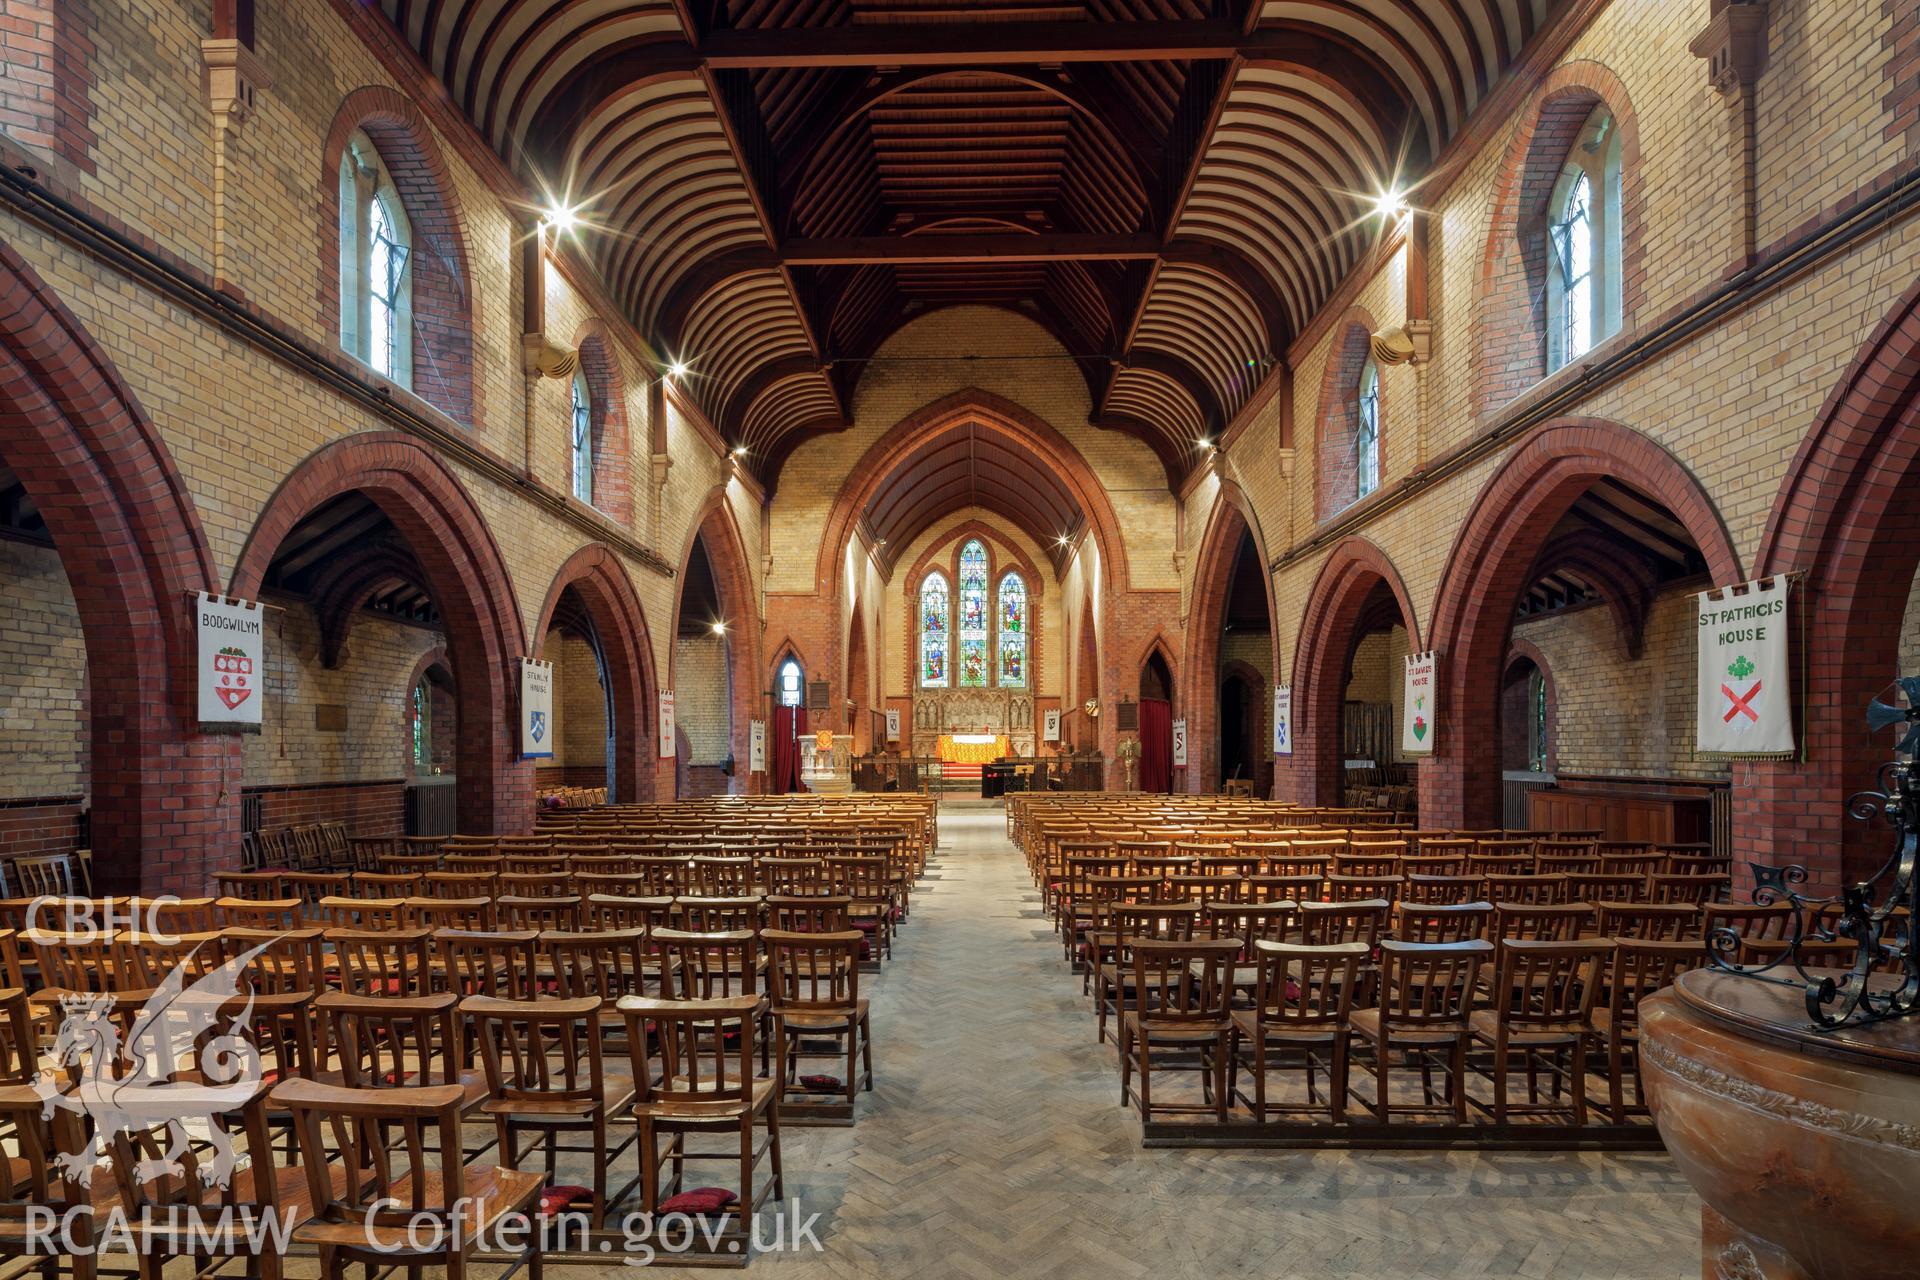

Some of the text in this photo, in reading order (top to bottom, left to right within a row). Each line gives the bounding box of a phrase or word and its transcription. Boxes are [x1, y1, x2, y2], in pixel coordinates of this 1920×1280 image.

[1700, 599, 1784, 626] ST PATRICKS
[202, 613, 260, 636] BODGWILYM
[1719, 627, 1767, 646] HOUSE
